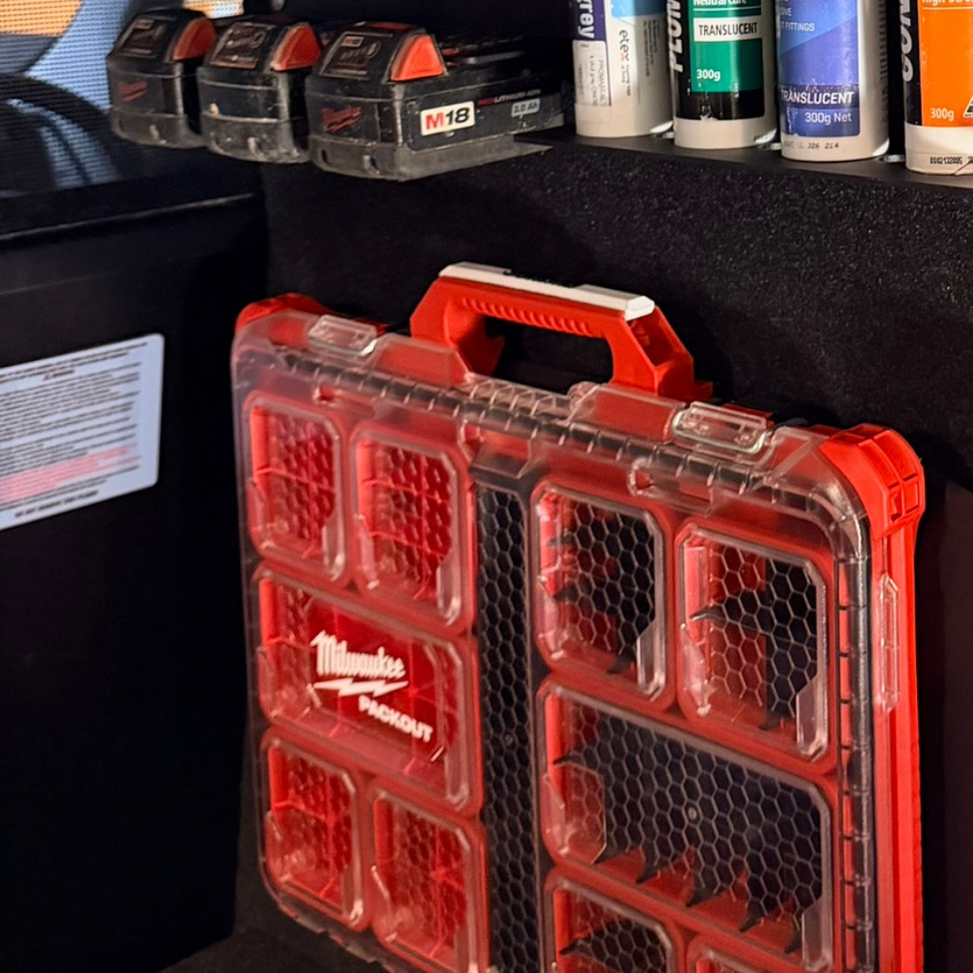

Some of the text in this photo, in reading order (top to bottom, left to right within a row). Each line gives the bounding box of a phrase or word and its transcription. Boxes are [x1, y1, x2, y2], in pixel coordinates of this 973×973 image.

[698, 22, 758, 36] TRANSLUCENT
[618, 29, 630, 62] etex
[696, 68, 721, 81] 300g
[781, 89, 855, 105] TRANSLUCENT
[425, 106, 470, 131] M18
[805, 112, 853, 126] 300g Net
[930, 107, 955, 122] 300g
[358, 694, 434, 743] PACKOUT
